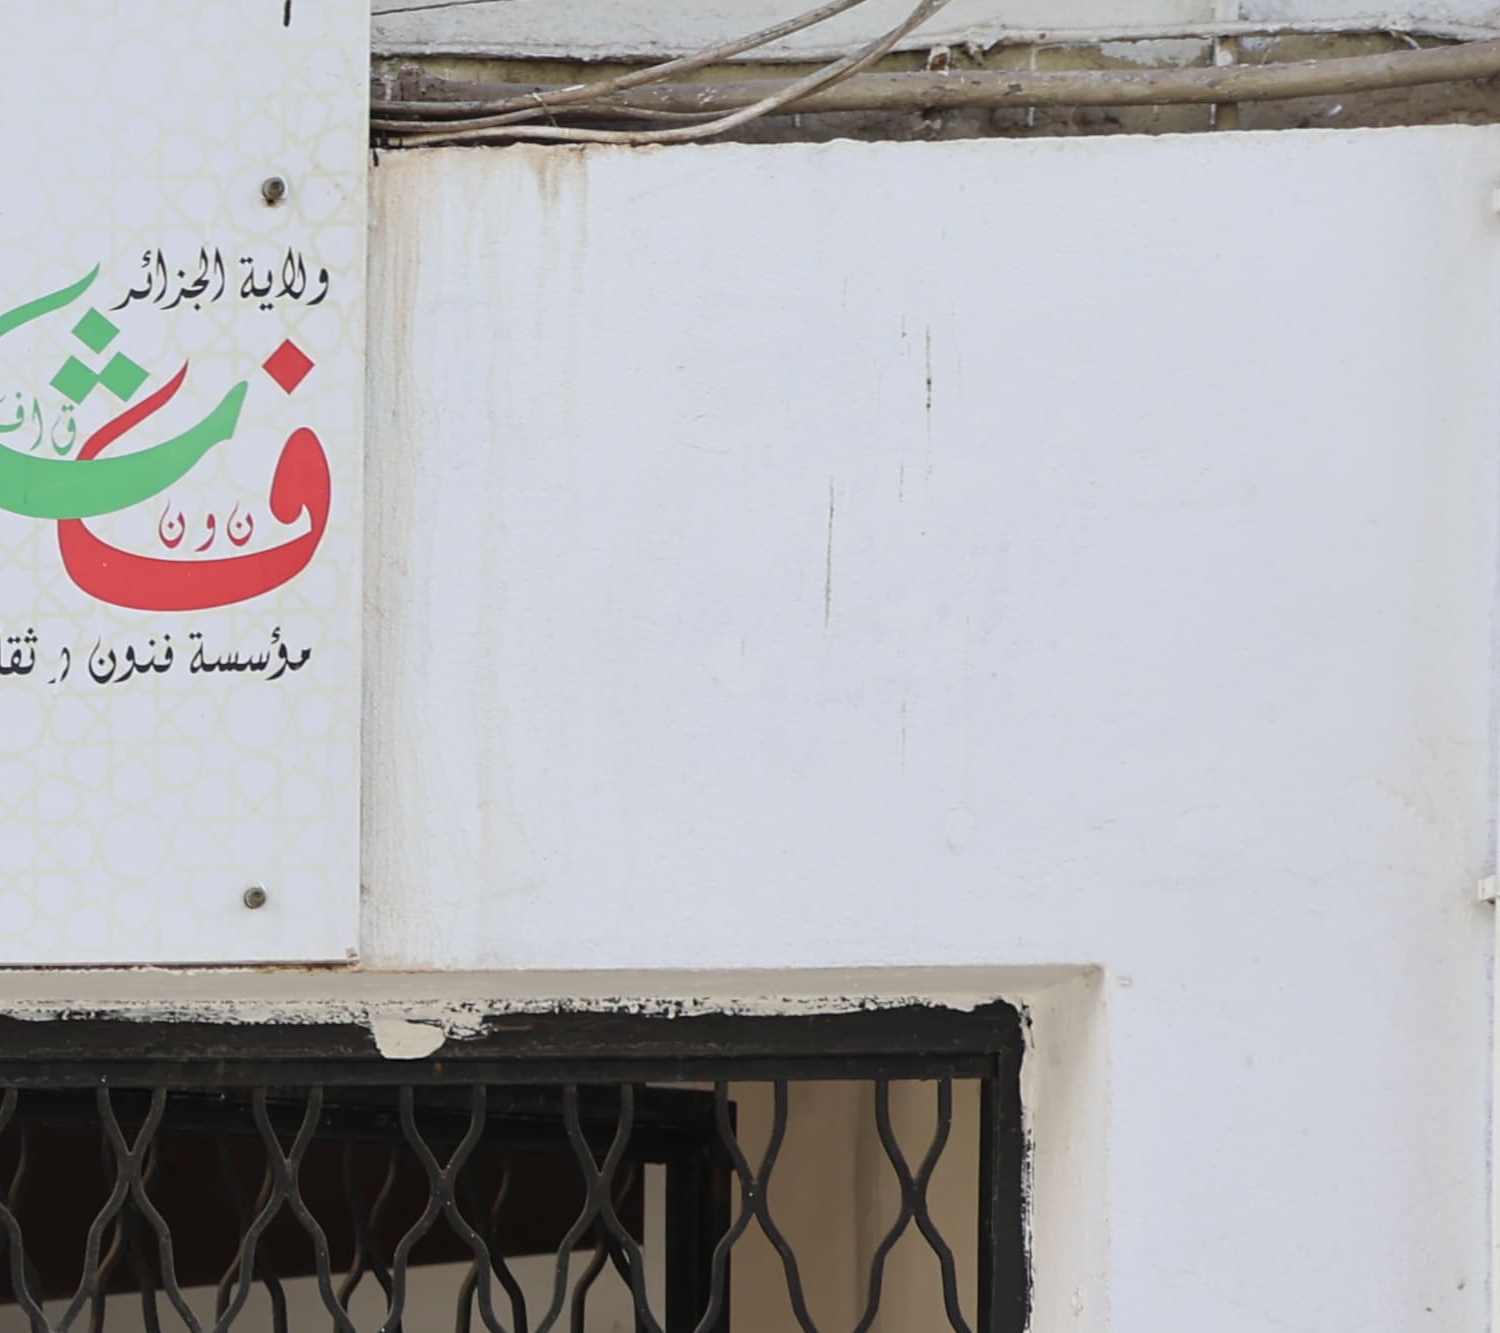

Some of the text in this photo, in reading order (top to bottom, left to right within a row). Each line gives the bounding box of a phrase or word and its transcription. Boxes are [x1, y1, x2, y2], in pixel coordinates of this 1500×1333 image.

[110, 247, 329, 311] ولاية الجزائر
[88, 634, 173, 684] فنون
[189, 627, 311, 682] مؤسسة
